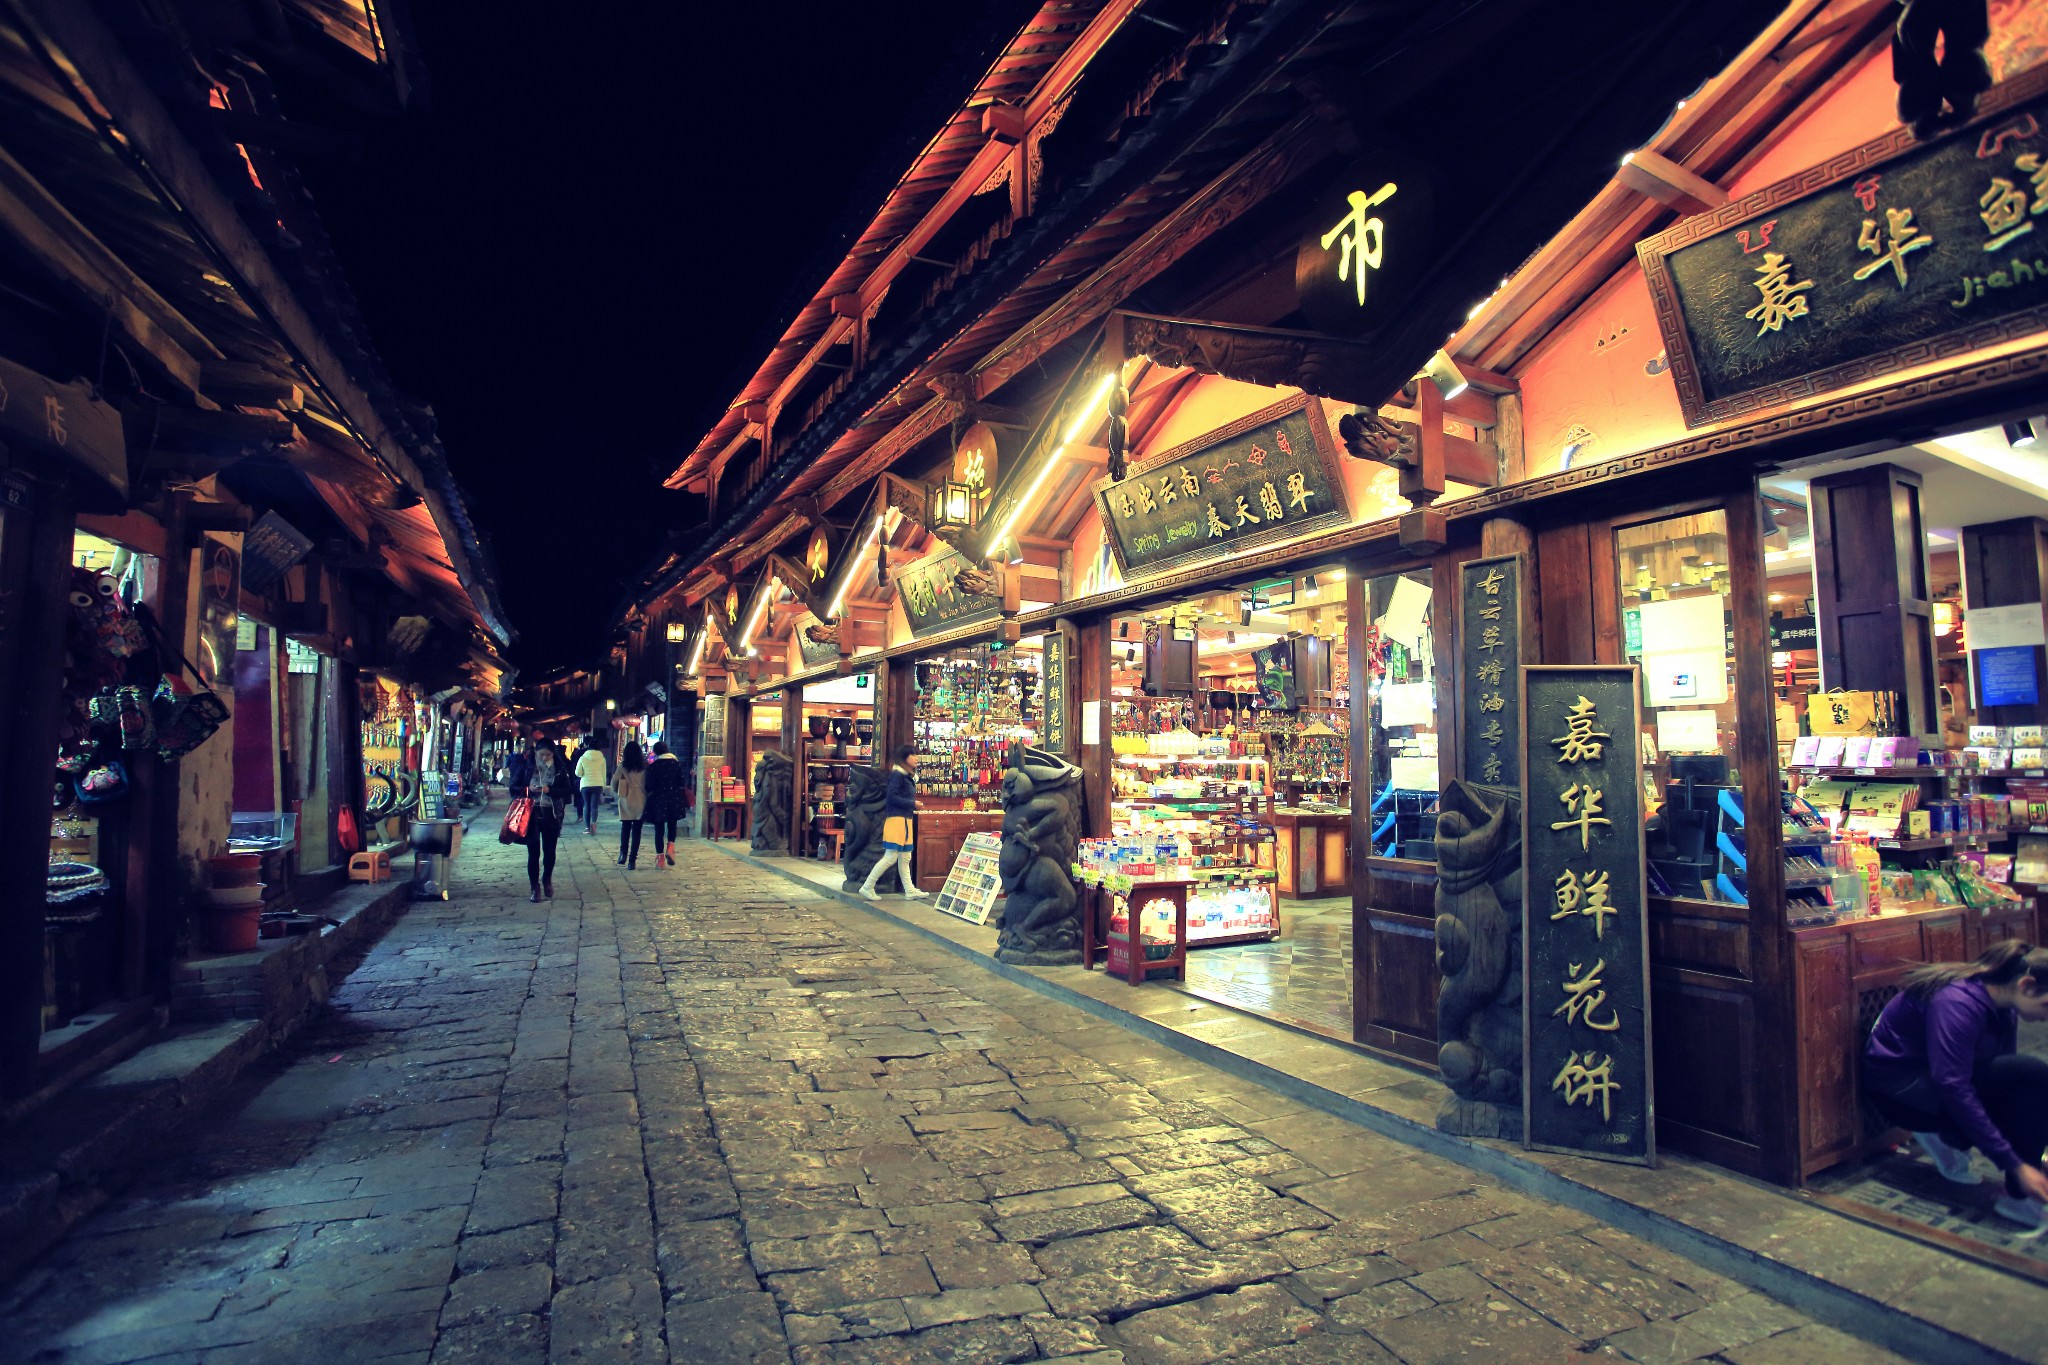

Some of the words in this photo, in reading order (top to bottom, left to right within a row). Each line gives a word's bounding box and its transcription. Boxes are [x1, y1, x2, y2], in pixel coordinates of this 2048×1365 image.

[1118, 466, 1200, 519] 玉出云南
[1206, 471, 1315, 538] 春天翡翠
[1048, 642, 1061, 744] 嘉华鲜花饼
[1551, 695, 1621, 1122] 嘉华鲜花饼
